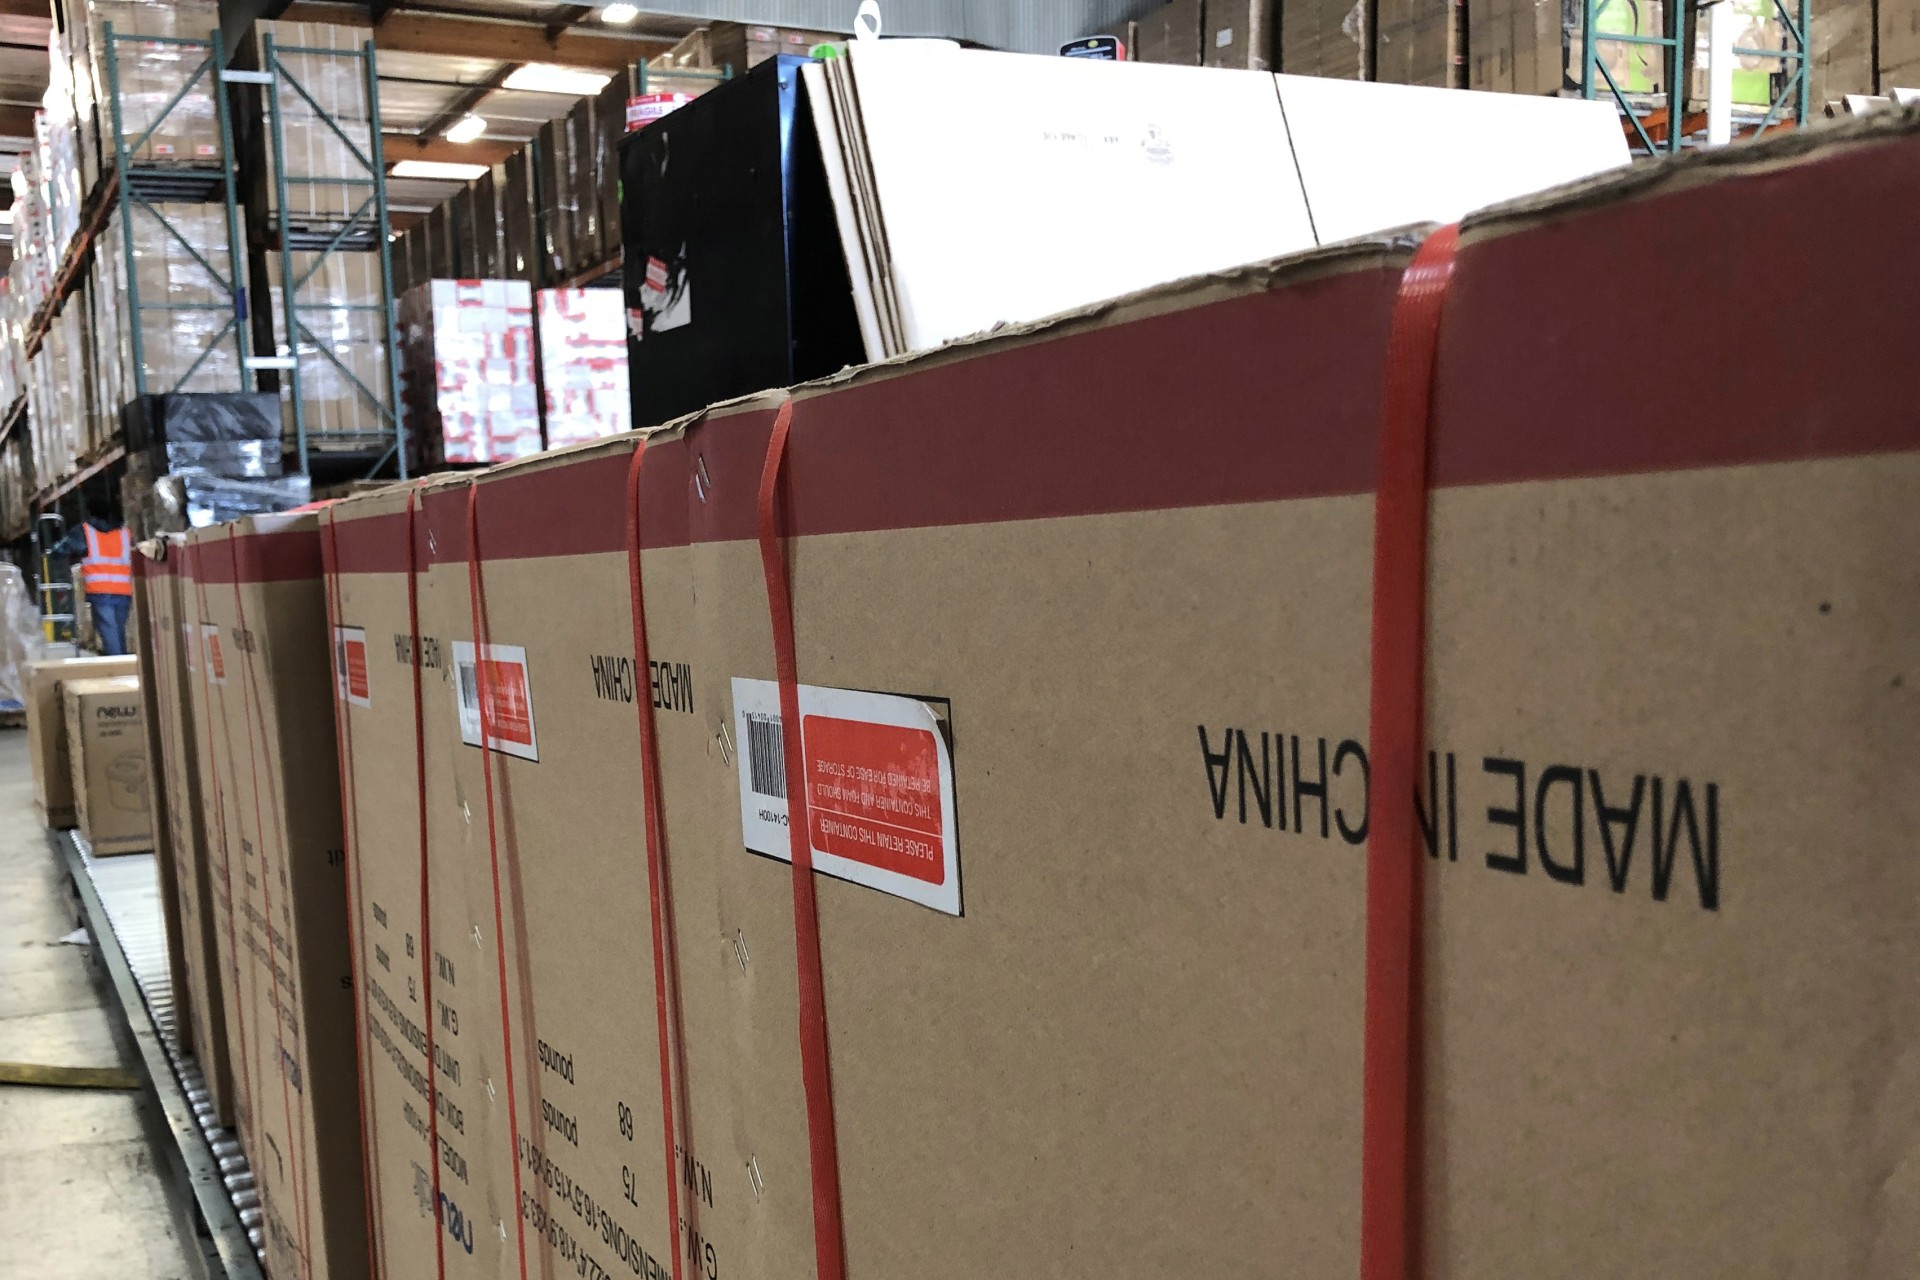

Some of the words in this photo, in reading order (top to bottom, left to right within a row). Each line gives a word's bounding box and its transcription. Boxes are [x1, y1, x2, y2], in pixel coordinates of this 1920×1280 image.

[590, 654, 633, 703] CHINA
[651, 660, 694, 714] MADE
[816, 759, 845, 776] STORAGE
[845, 765, 855, 778] OF
[855, 766, 873, 782] EASE
[873, 770, 887, 785] FOR
[816, 783, 842, 800] SHOULD
[887, 772, 921, 790] RETAINED
[921, 778, 932, 793] BE
[1197, 724, 1371, 846] CHINA
[842, 787, 860, 804] FOAM
[861, 792, 875, 807] AND
[875, 795, 913, 816] CONTAINER
[914, 803, 931, 820] THIS
[820, 818, 858, 840] CONTAINER
[858, 827, 876, 845] THIS
[1482, 755, 1721, 912] MADE
[877, 831, 904, 852] RETAIN
[905, 838, 934, 861] PLEASE
[538, 1039, 575, 1086] pounds
[541, 1098, 578, 1149] pounds
[617, 1100, 634, 1142] 68
[622, 1165, 639, 1208] 75
